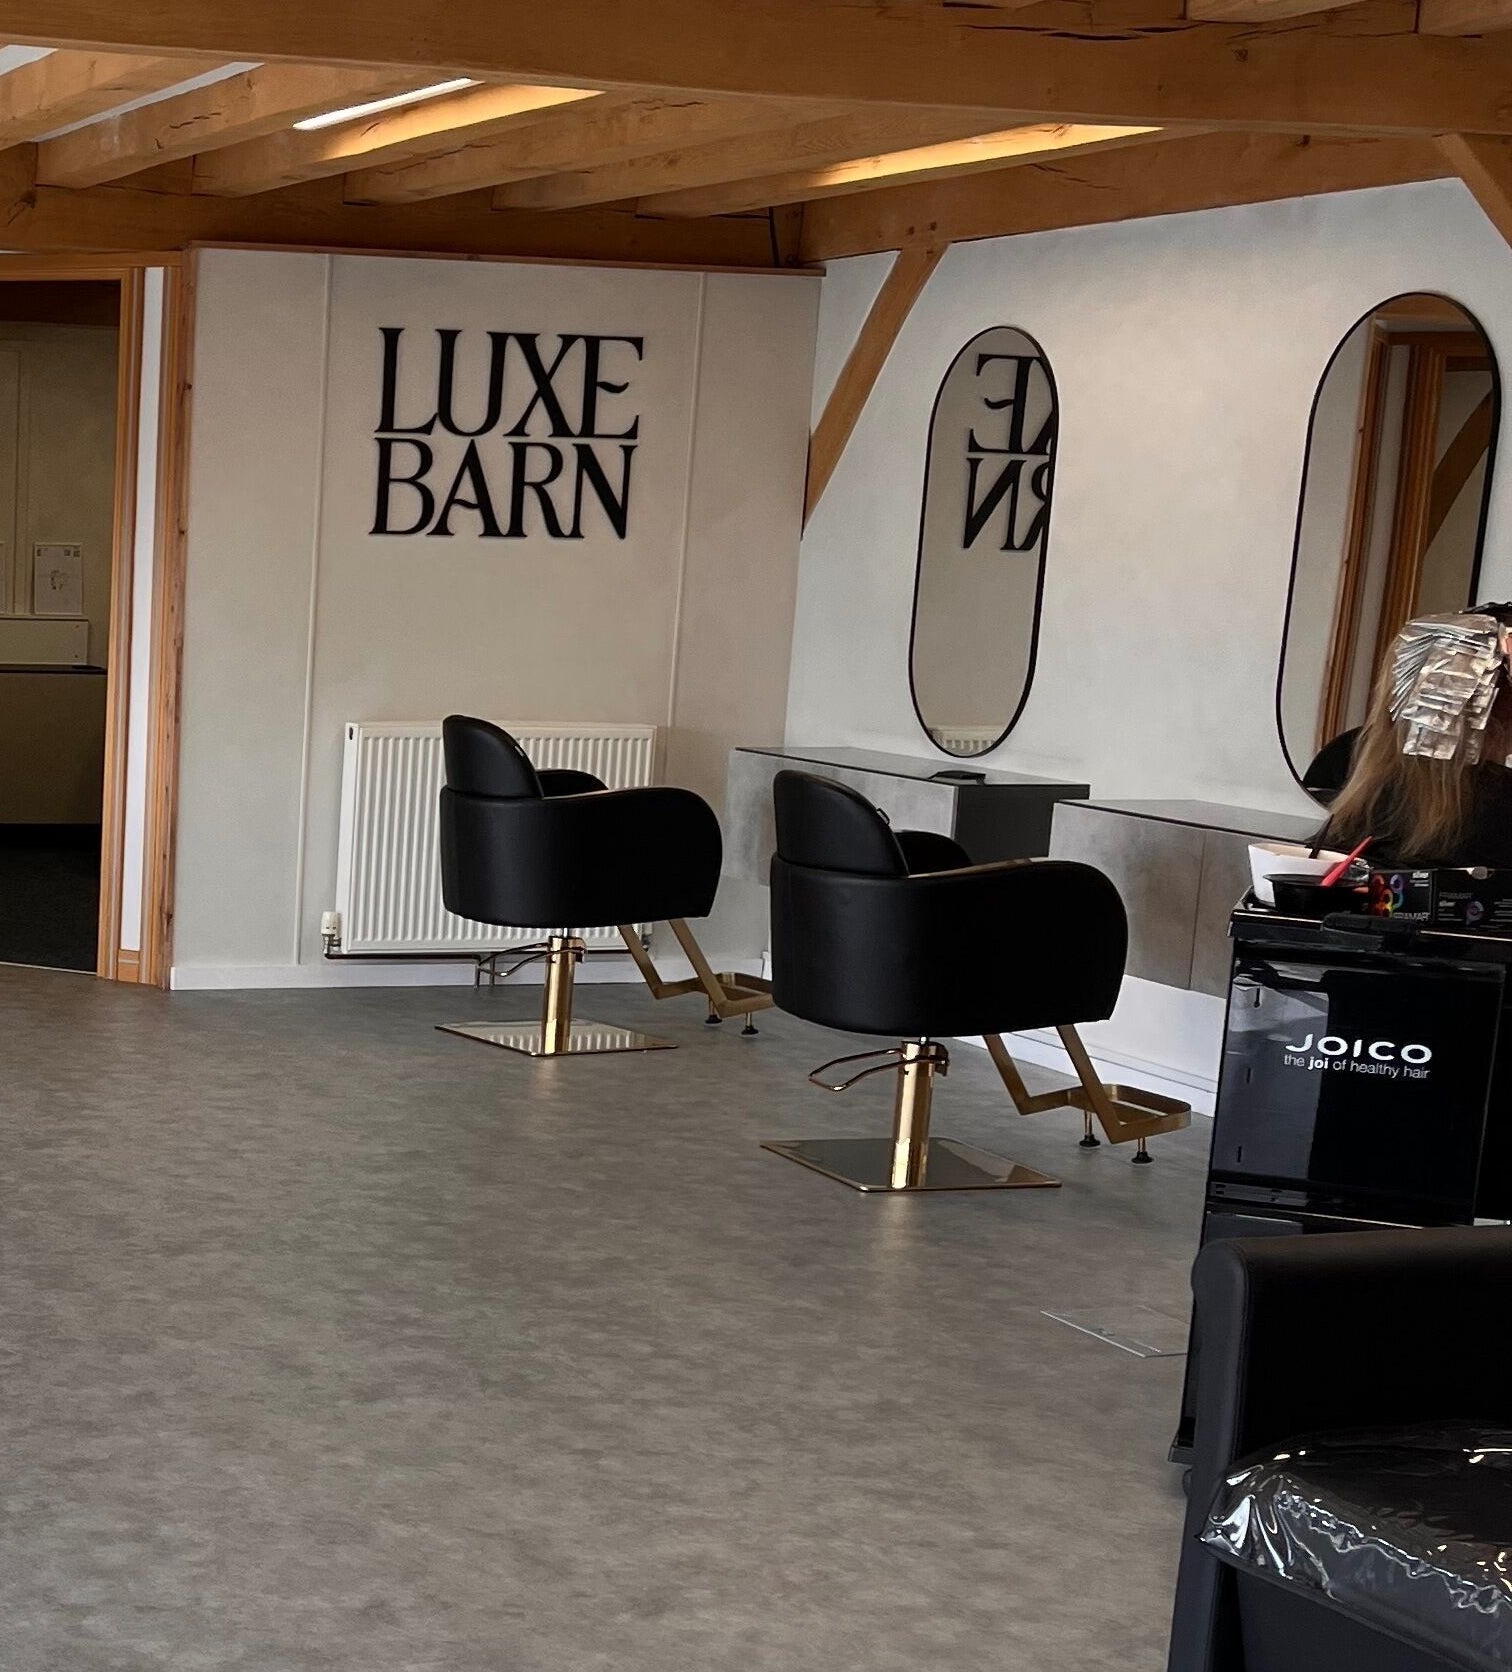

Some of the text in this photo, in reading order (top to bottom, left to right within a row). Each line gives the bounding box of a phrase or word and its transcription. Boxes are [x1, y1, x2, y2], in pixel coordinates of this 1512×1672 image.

[374, 327, 644, 440] LUXE
[368, 437, 638, 540] BARN
[1283, 1053, 1431, 1080] the joi of healthy hair
[1285, 1033, 1433, 1064] JOICO
